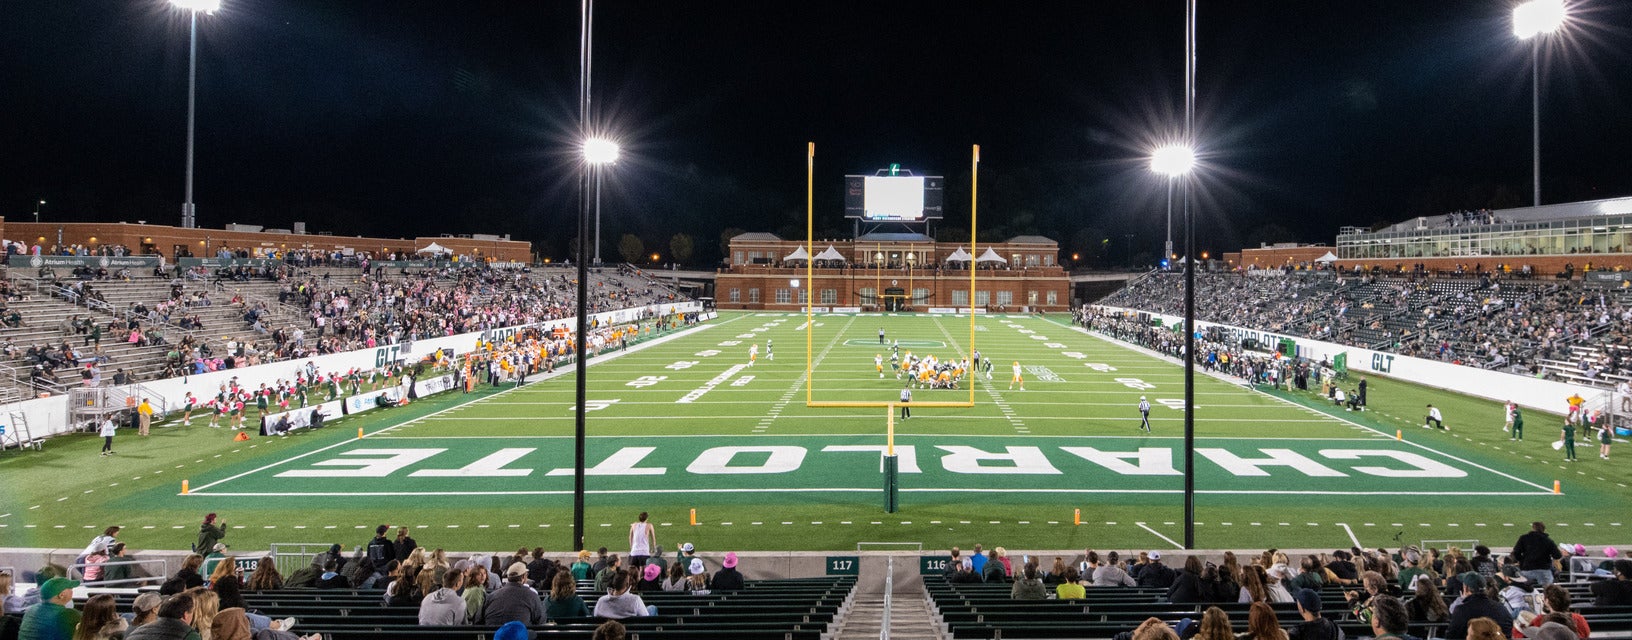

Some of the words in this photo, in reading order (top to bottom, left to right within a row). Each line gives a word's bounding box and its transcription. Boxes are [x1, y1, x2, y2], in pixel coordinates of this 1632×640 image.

[1371, 353, 1394, 373] CLT
[273, 446, 1469, 478] CHARLOTTE
[238, 560, 258, 570] 118
[832, 560, 852, 570] 117
[927, 560, 946, 570] 116
